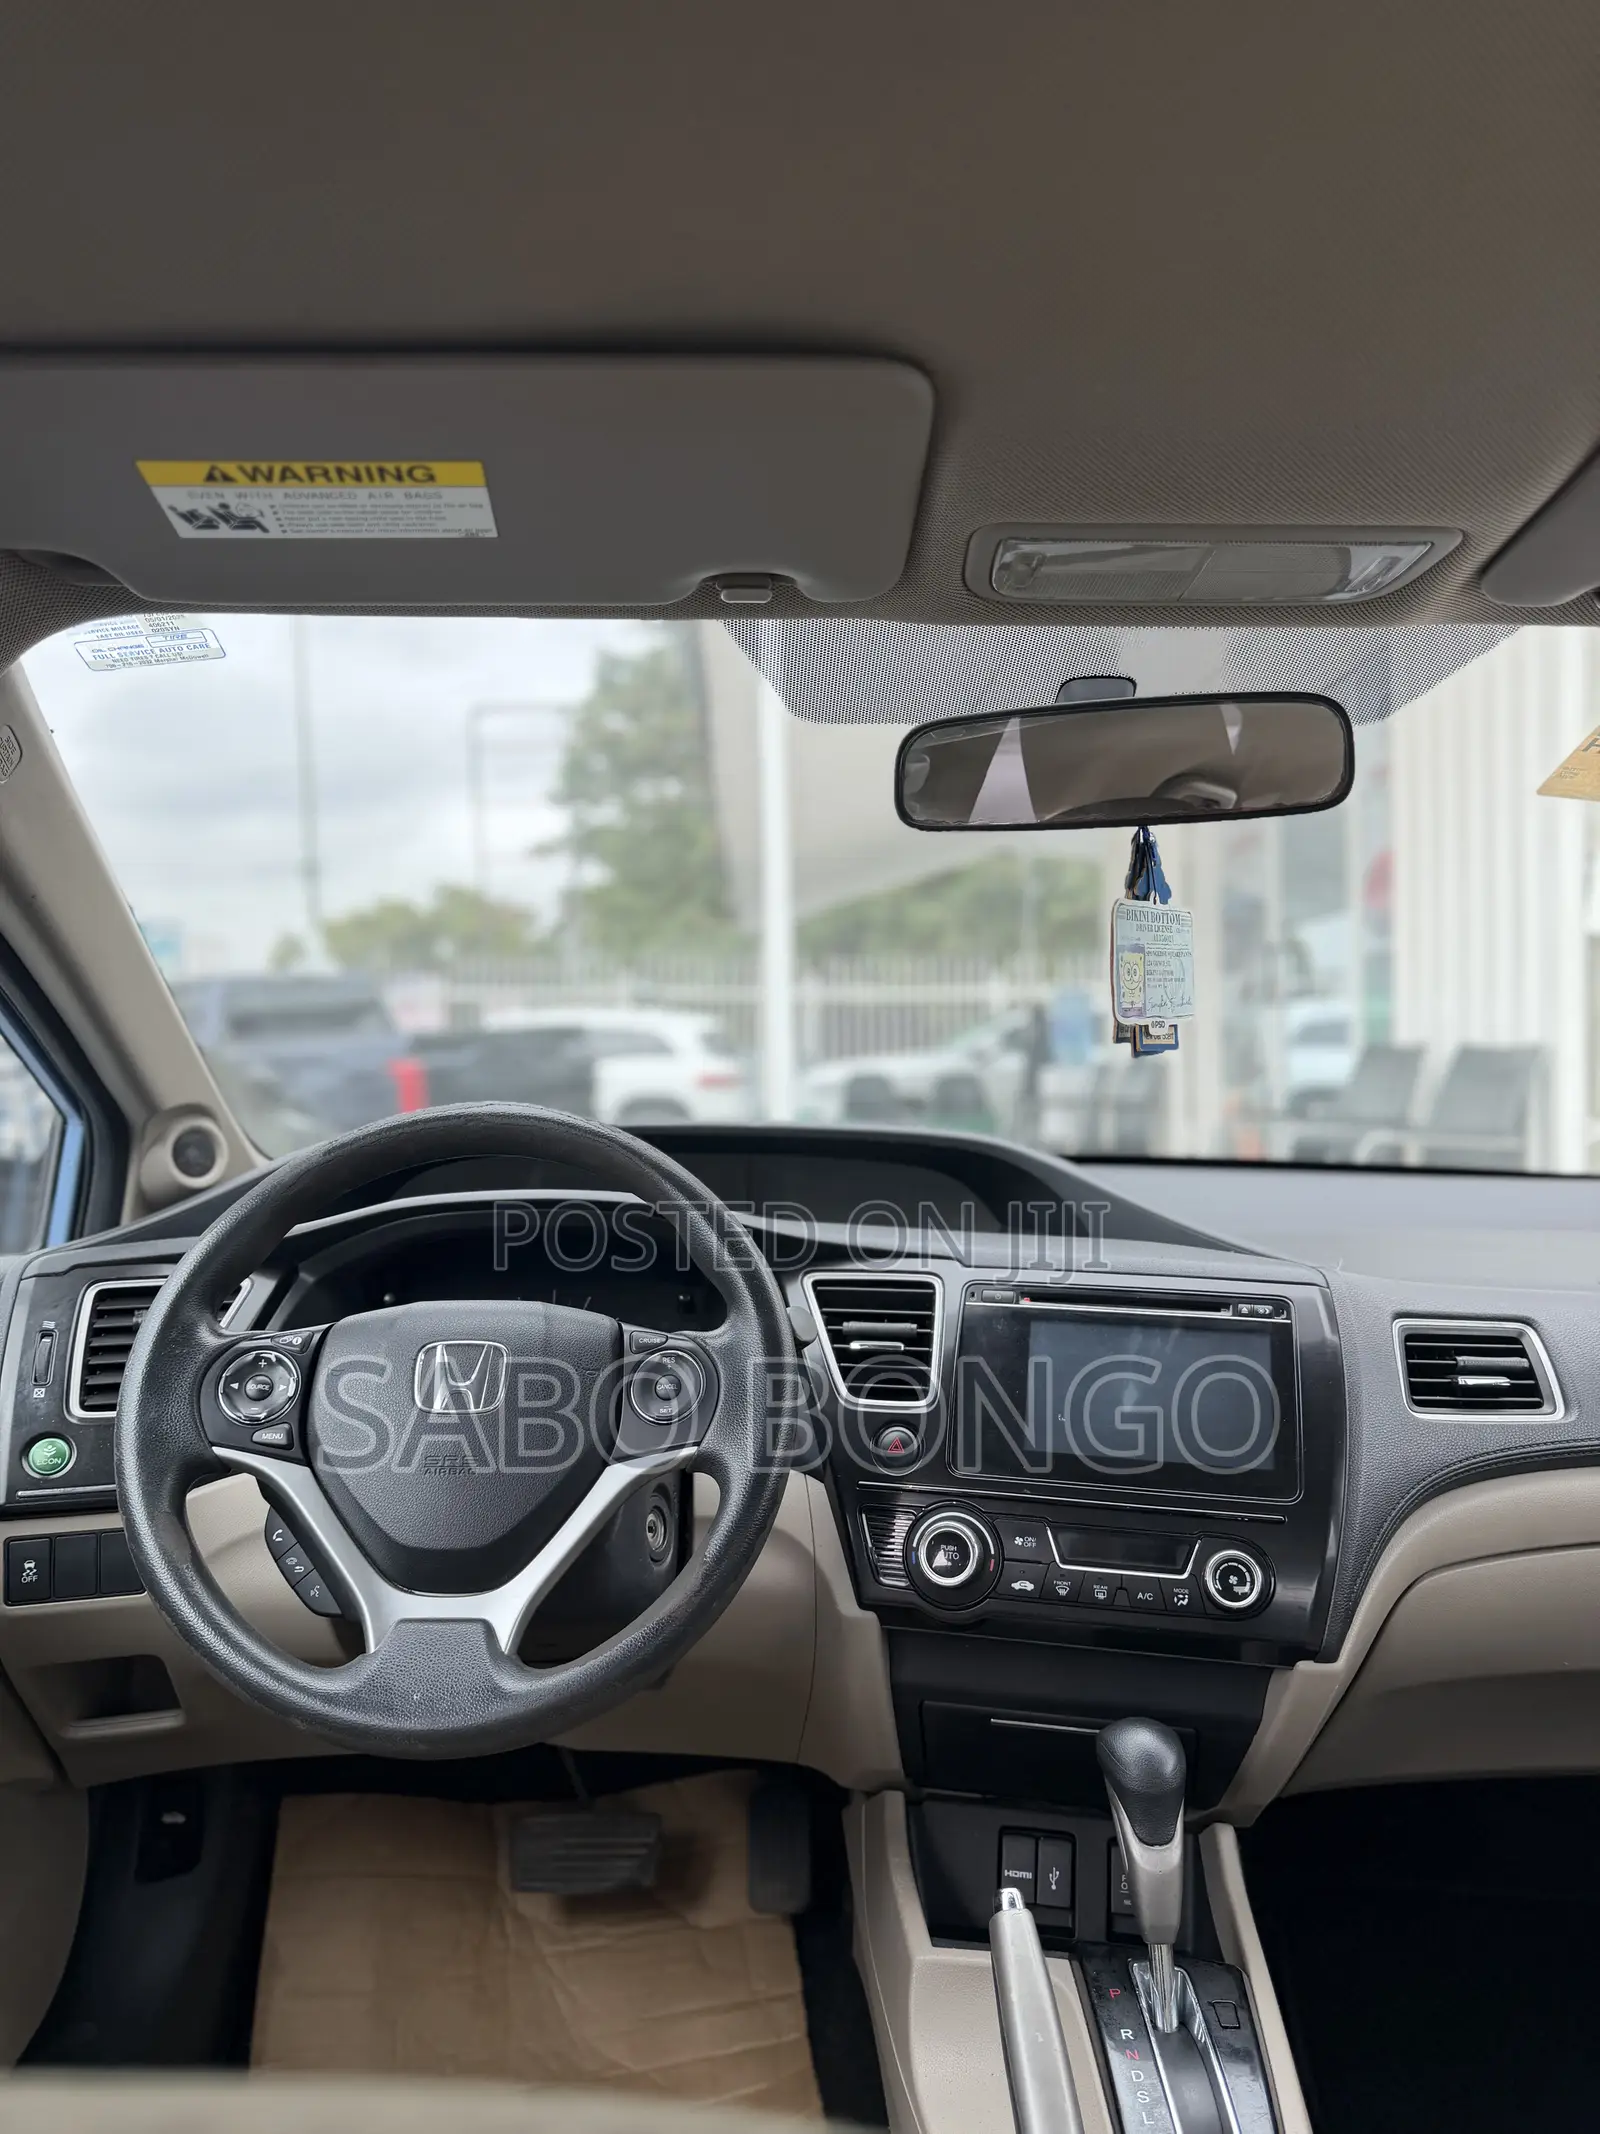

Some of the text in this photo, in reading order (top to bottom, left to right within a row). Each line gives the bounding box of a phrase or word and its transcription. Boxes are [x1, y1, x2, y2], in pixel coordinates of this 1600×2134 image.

[236, 464, 437, 483] WARNING
[187, 491, 443, 500] EVEN WITH ADVANCED AIR BAGS
[93, 643, 211, 661] FULL SERVICE AUTO CARE
[4, 735, 17, 756] SIDE
[0, 736, 15, 768] URTAIN
[1126, 909, 1181, 926] BIKINI BOTTOM
[1136, 923, 1153, 933] DRIVER
[1154, 924, 1173, 934] LICENSE
[662, 1356, 676, 1364] RES
[247, 1382, 270, 1391] SOURCE
[657, 1383, 678, 1391] CANCEL
[261, 1432, 284, 1441] MENU
[36, 1457, 62, 1467] ECON
[424, 1468, 478, 1476] AIRBAG
[940, 1544, 957, 1552] PUSH
[21, 1574, 38, 1584] OFF
[1137, 1591, 1154, 1601] A/C
[1004, 1869, 1032, 1880] HDMI
[1109, 1988, 1121, 1999] P
[1120, 2029, 1135, 2040] R
[1125, 2048, 1139, 2061] N
[1131, 2070, 1144, 2082] D
[1137, 2091, 1150, 2104] S
[1142, 2111, 1155, 2124] L
